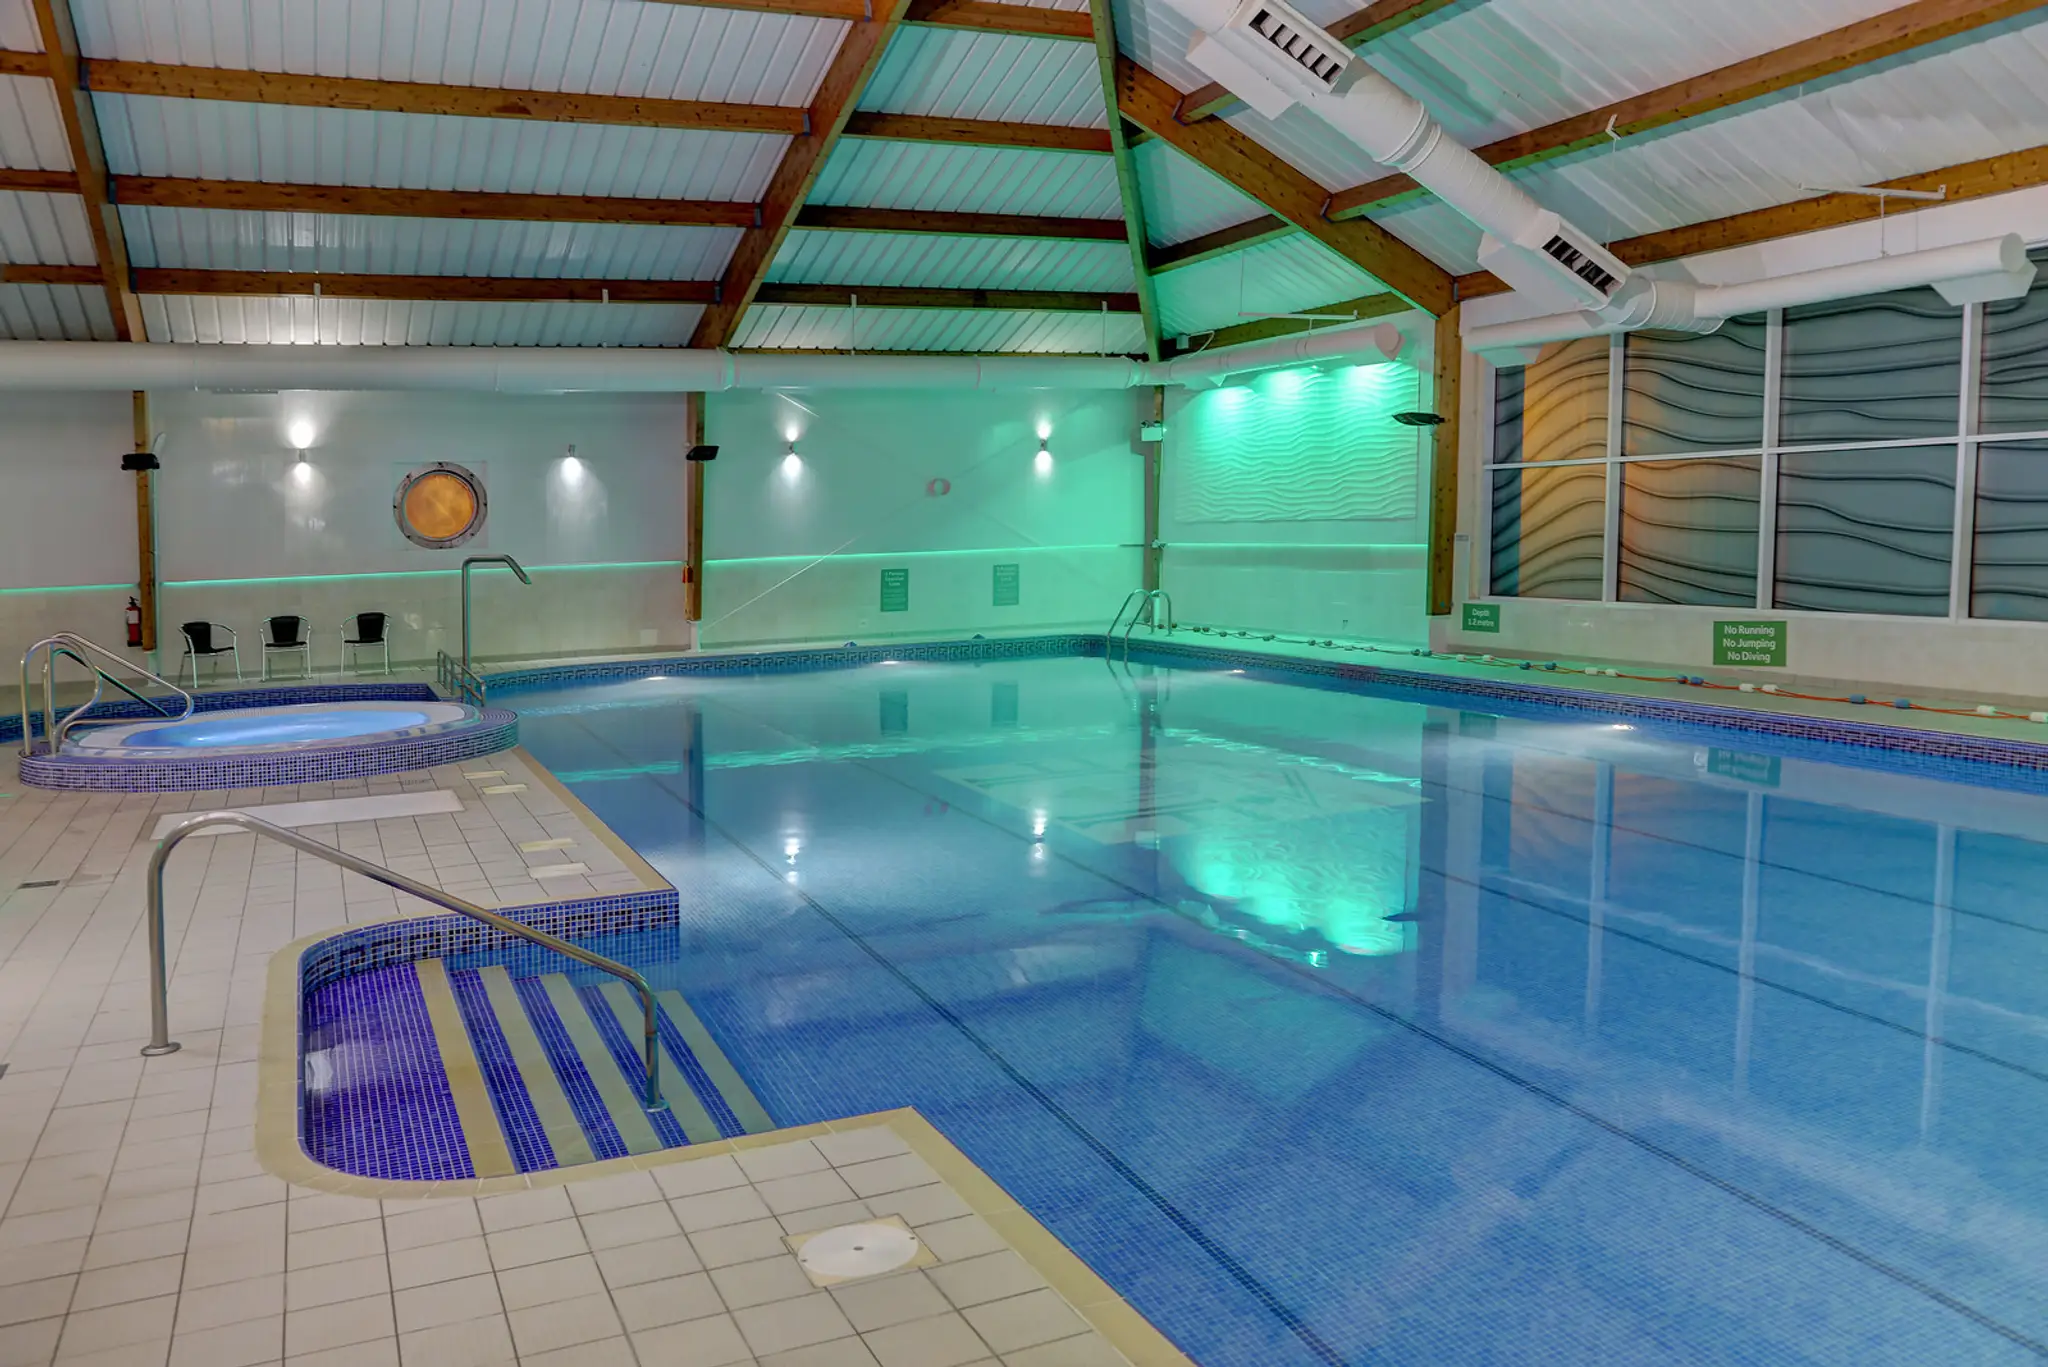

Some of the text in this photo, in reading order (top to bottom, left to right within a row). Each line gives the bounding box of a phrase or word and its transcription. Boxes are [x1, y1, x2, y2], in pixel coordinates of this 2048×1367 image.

[1472, 608, 1490, 618] Depth
[1724, 625, 1775, 637] No Running
[1723, 638, 1776, 650] No Jumping
[1727, 651, 1771, 664] No Diving
